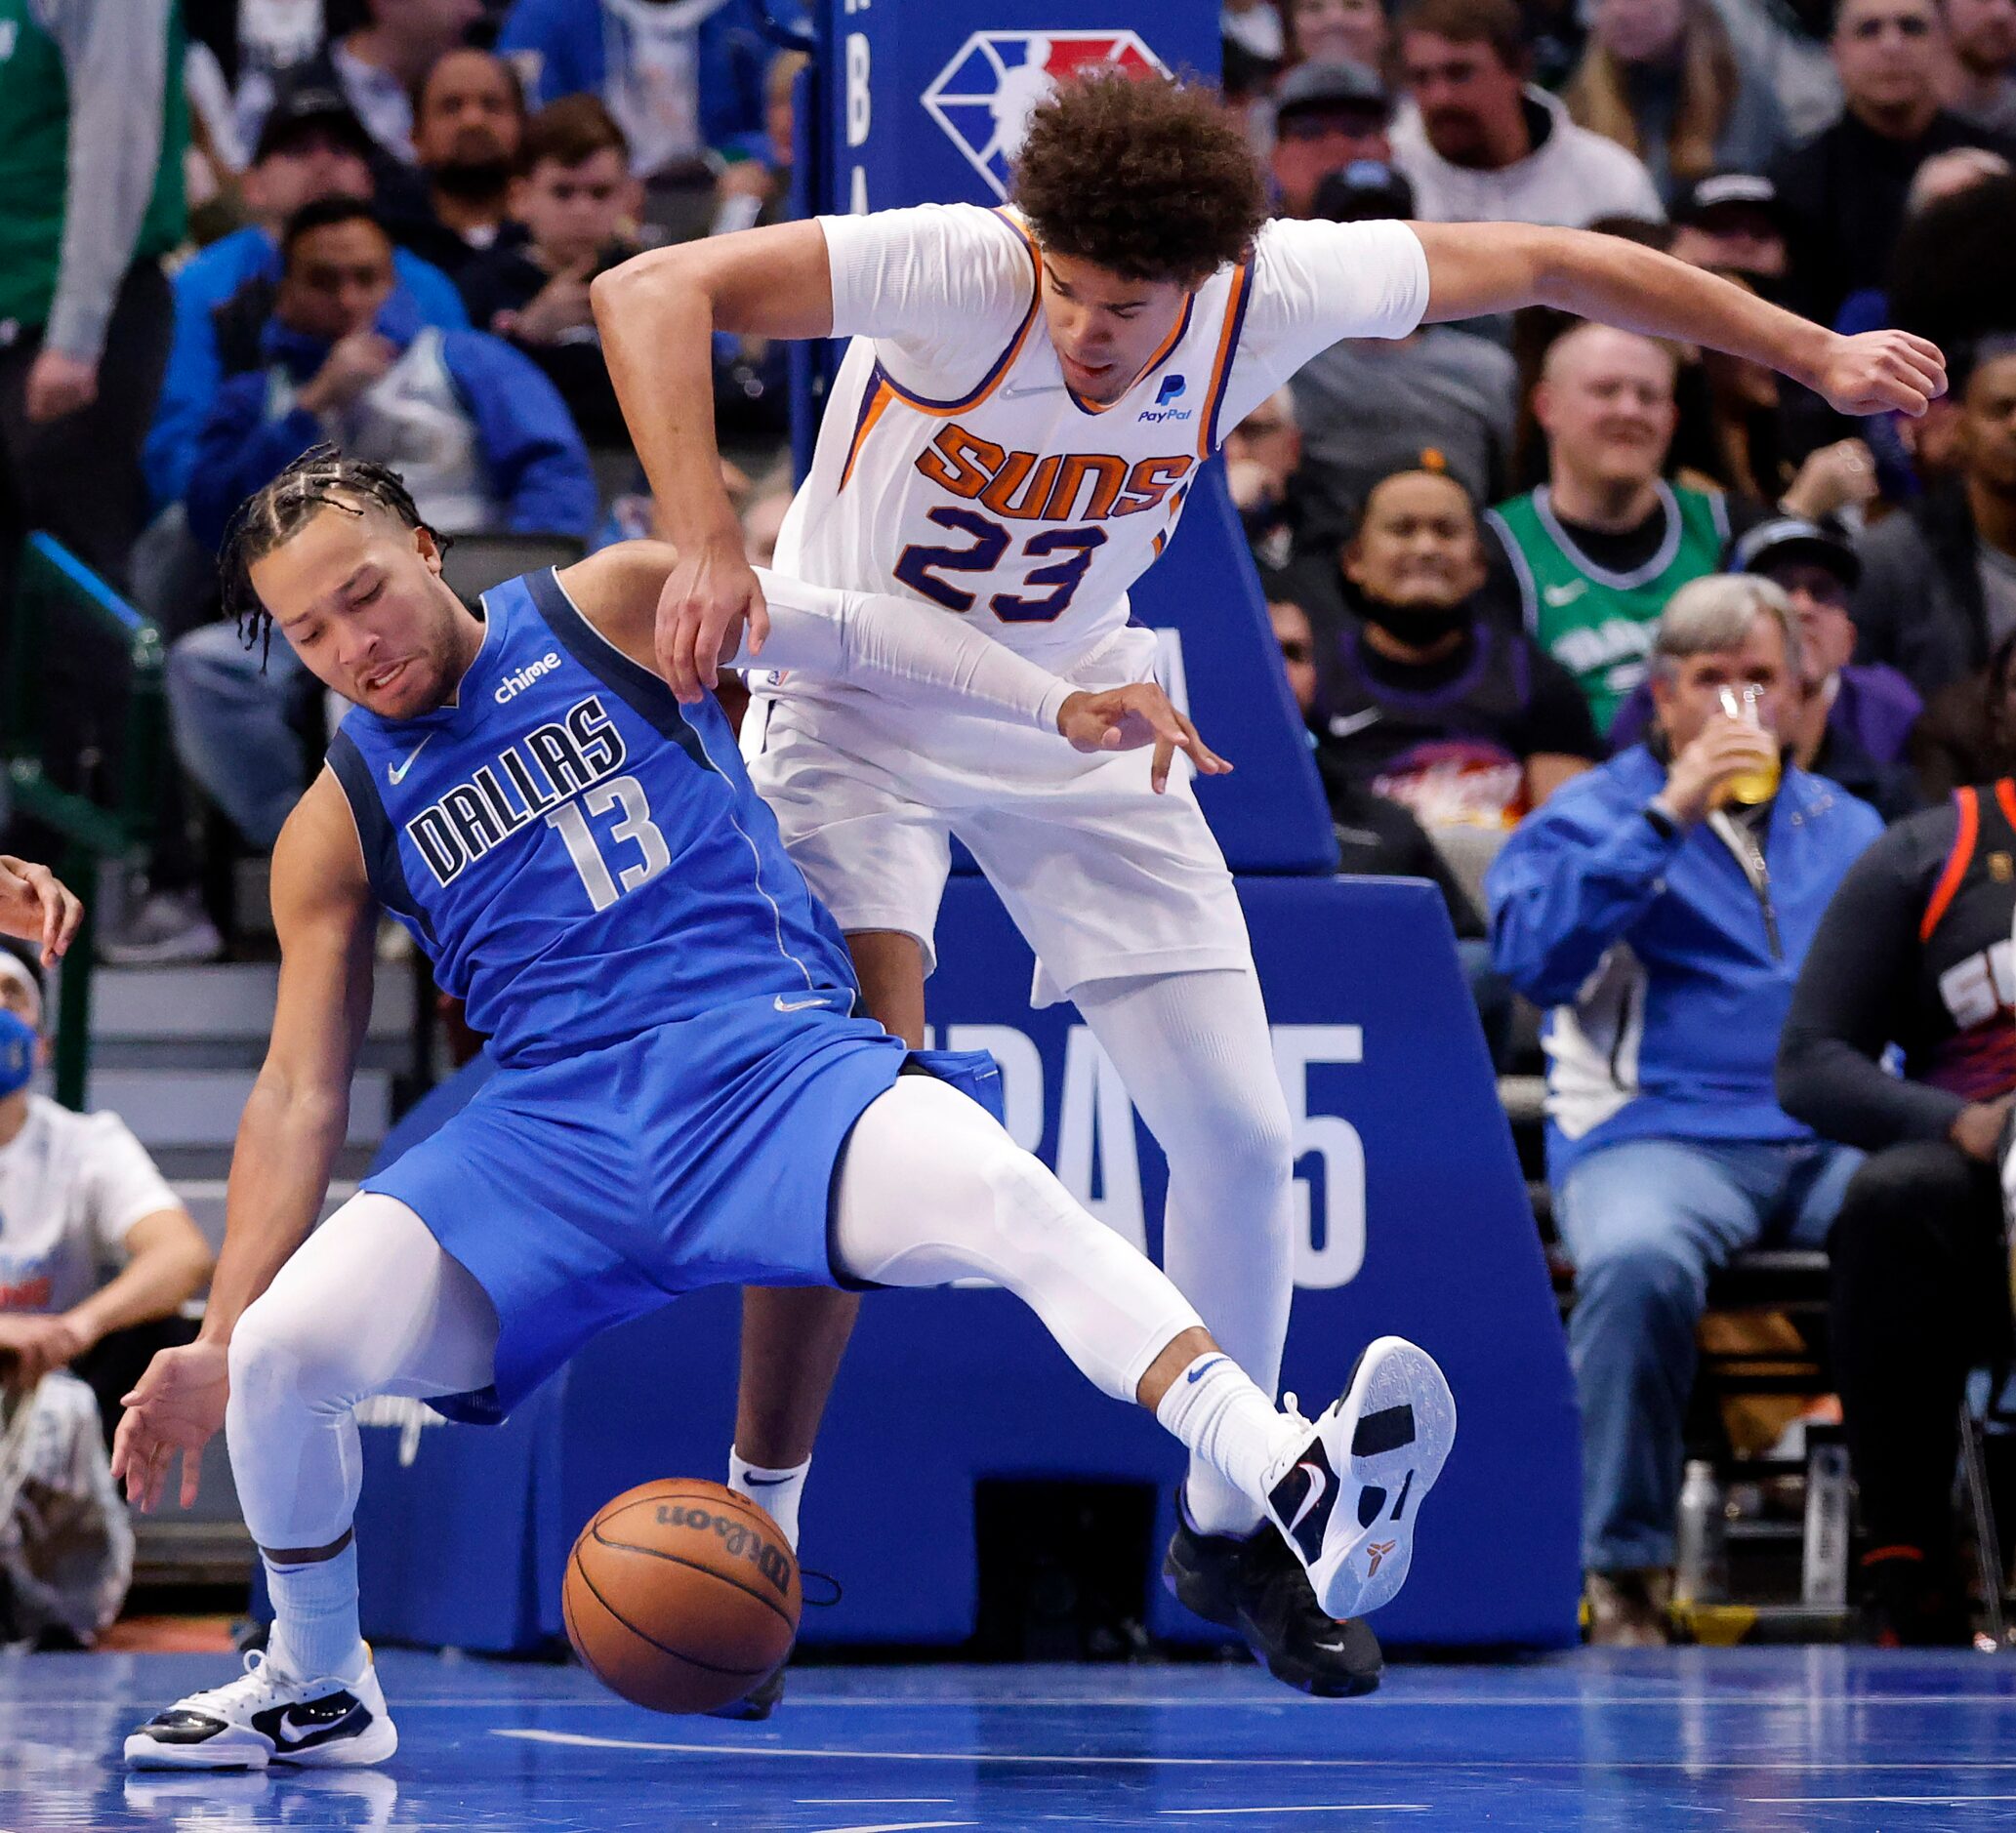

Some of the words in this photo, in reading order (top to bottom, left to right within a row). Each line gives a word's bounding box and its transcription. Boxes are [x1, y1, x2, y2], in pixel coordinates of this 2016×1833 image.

[1138, 409, 1192, 423] PayPal
[892, 506, 1108, 623] 23
[495, 652, 562, 704] chime
[406, 695, 626, 888] DALLAS
[545, 776, 672, 912] 13
[655, 1504, 791, 1596] Wilson
